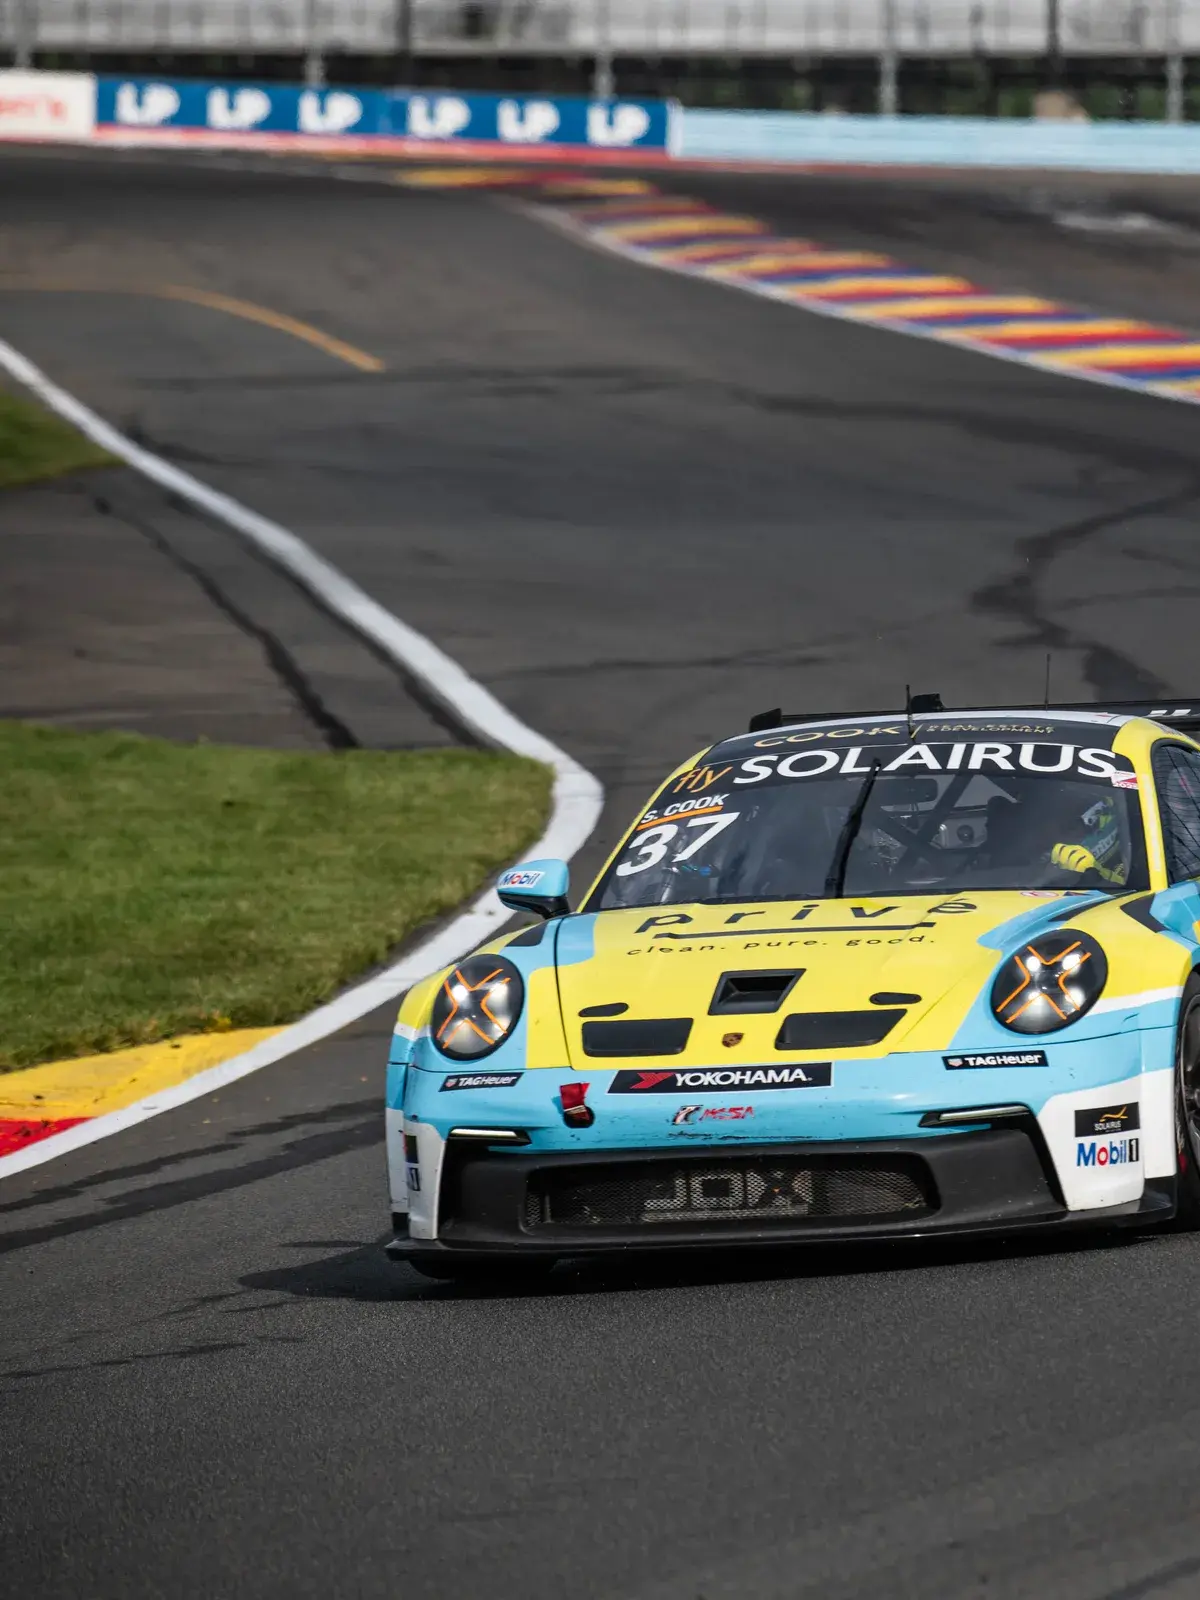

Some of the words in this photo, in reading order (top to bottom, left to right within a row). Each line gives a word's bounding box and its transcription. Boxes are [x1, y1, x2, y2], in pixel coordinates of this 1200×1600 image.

[754, 726, 903, 748] COOK
[672, 766, 733, 793] fly
[733, 743, 1116, 784] SOLAIRUS
[641, 810, 658, 823] S.
[664, 793, 730, 816] COOK
[616, 812, 740, 876] 37
[500, 872, 540, 885] Mobil
[633, 898, 978, 934] privé
[627, 945, 726, 955] clean.
[744, 939, 827, 950] pure.
[846, 935, 935, 946] good.
[675, 1068, 809, 1086] YOKOHAMA
[1077, 1140, 1127, 1167] Mobil
